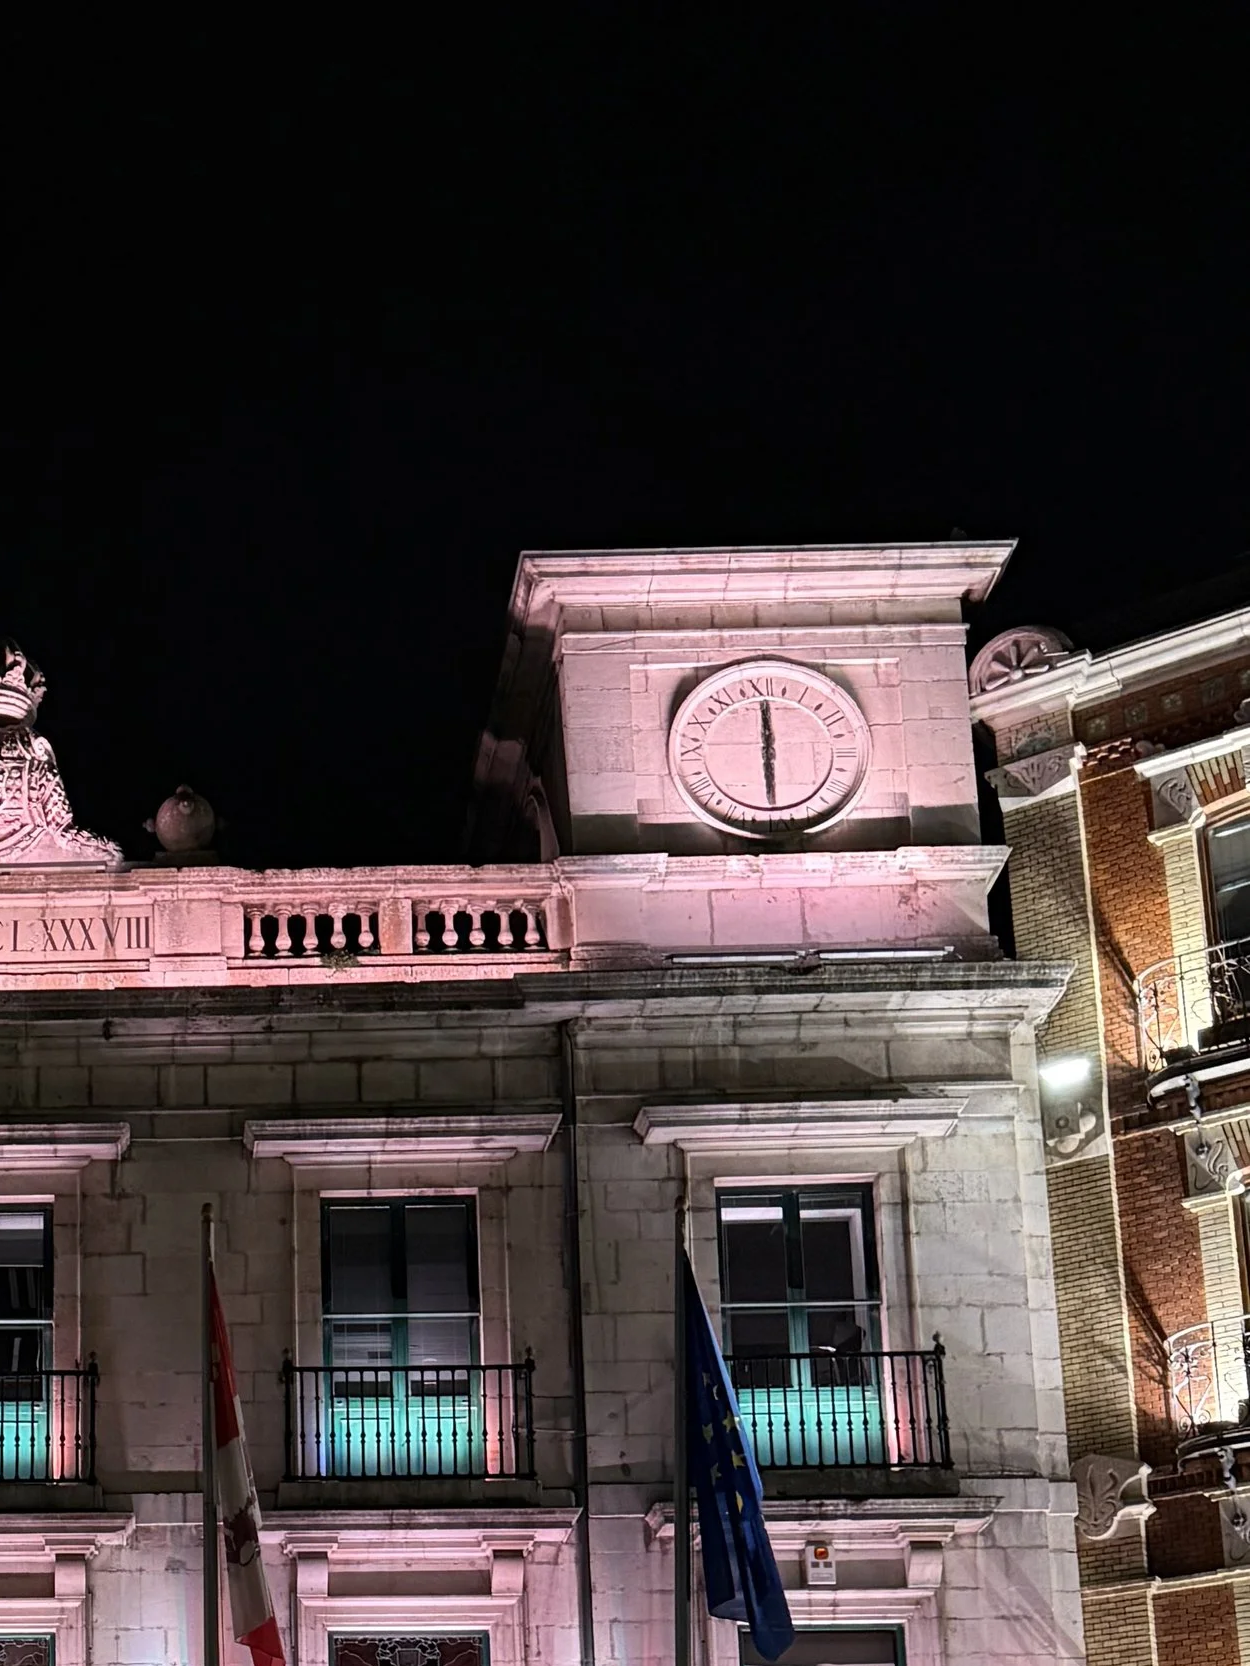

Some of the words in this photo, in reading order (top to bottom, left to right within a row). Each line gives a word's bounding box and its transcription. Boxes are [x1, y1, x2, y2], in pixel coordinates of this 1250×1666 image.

[749, 678, 773, 696] XII
[709, 687, 735, 709] XI
[687, 714, 712, 732] X
[822, 709, 845, 727] II
[680, 743, 703, 762] IX
[834, 747, 858, 759] III
